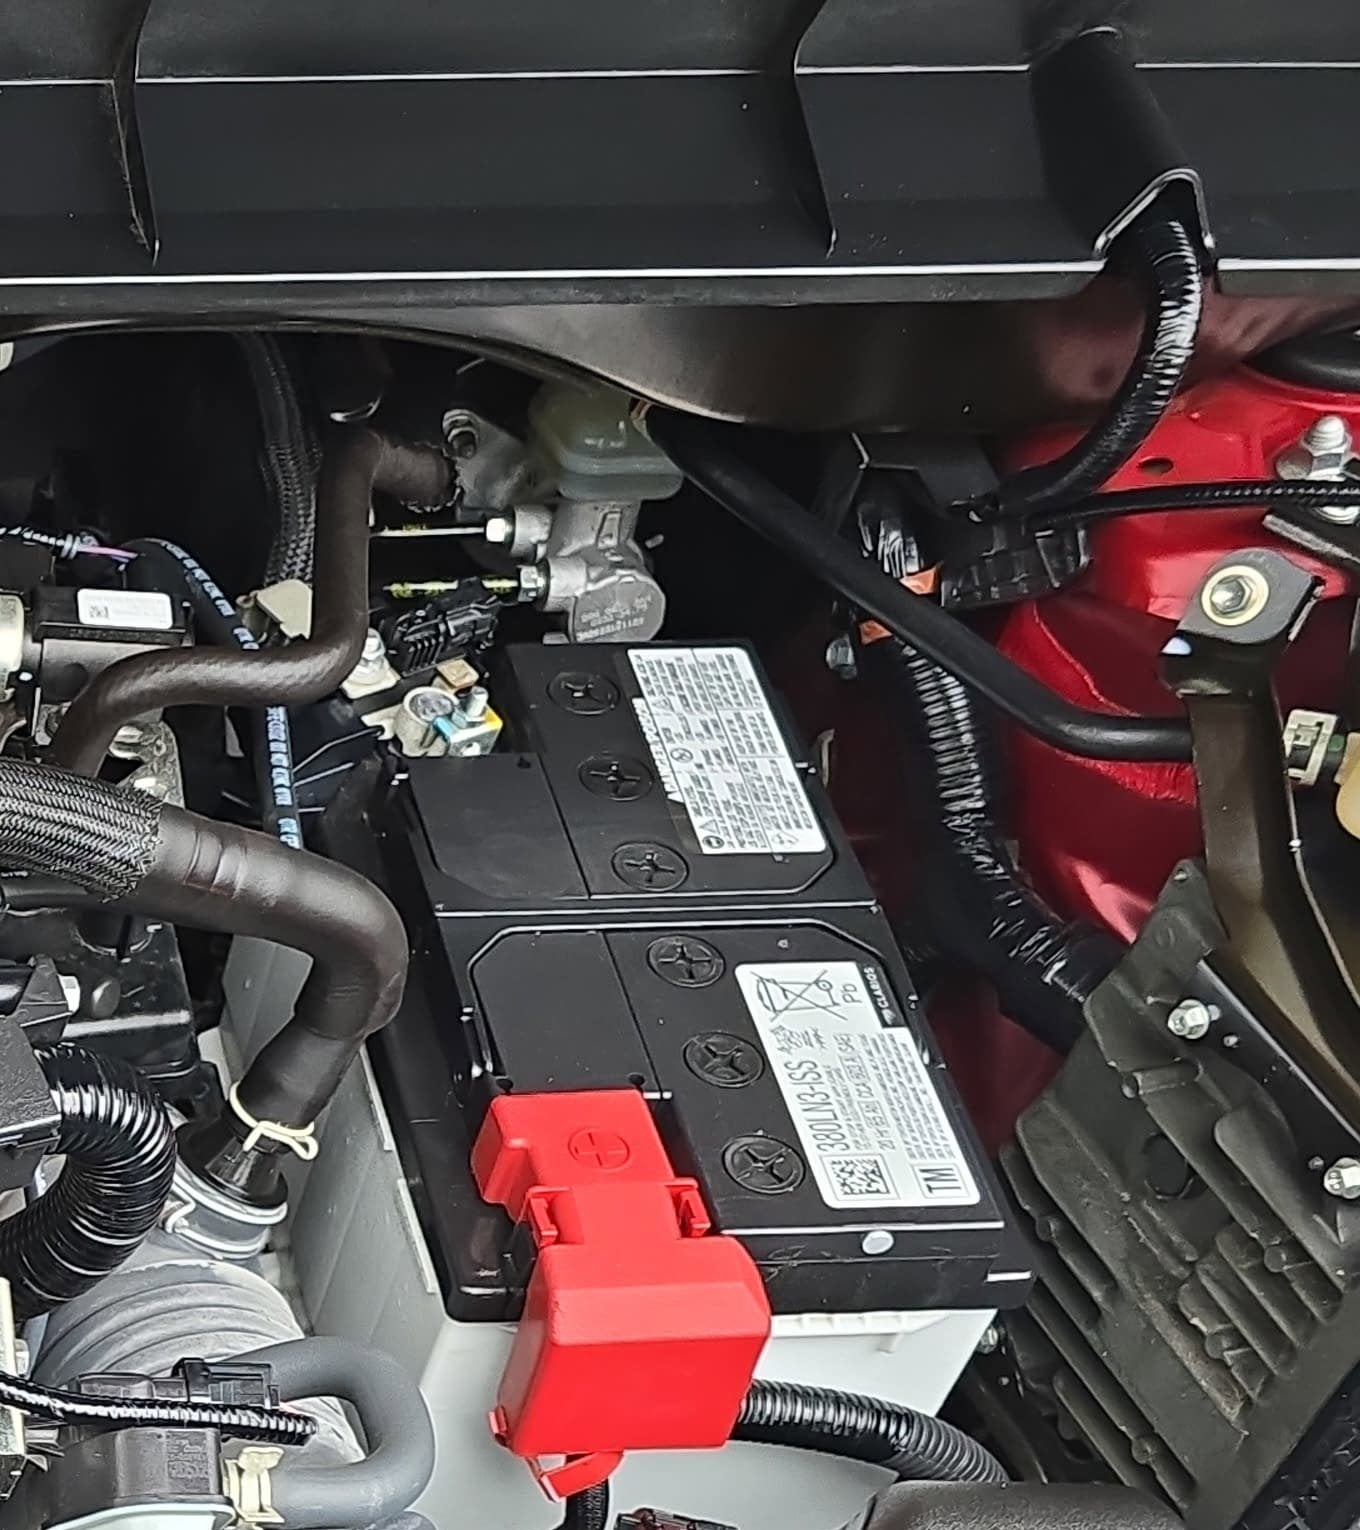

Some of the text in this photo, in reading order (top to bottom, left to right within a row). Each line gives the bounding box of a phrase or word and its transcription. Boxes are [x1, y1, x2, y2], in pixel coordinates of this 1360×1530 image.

[841, 983, 863, 1003] Pb
[783, 1059, 851, 1152] 380LN3-ISS
[919, 1167, 963, 1194] TM
